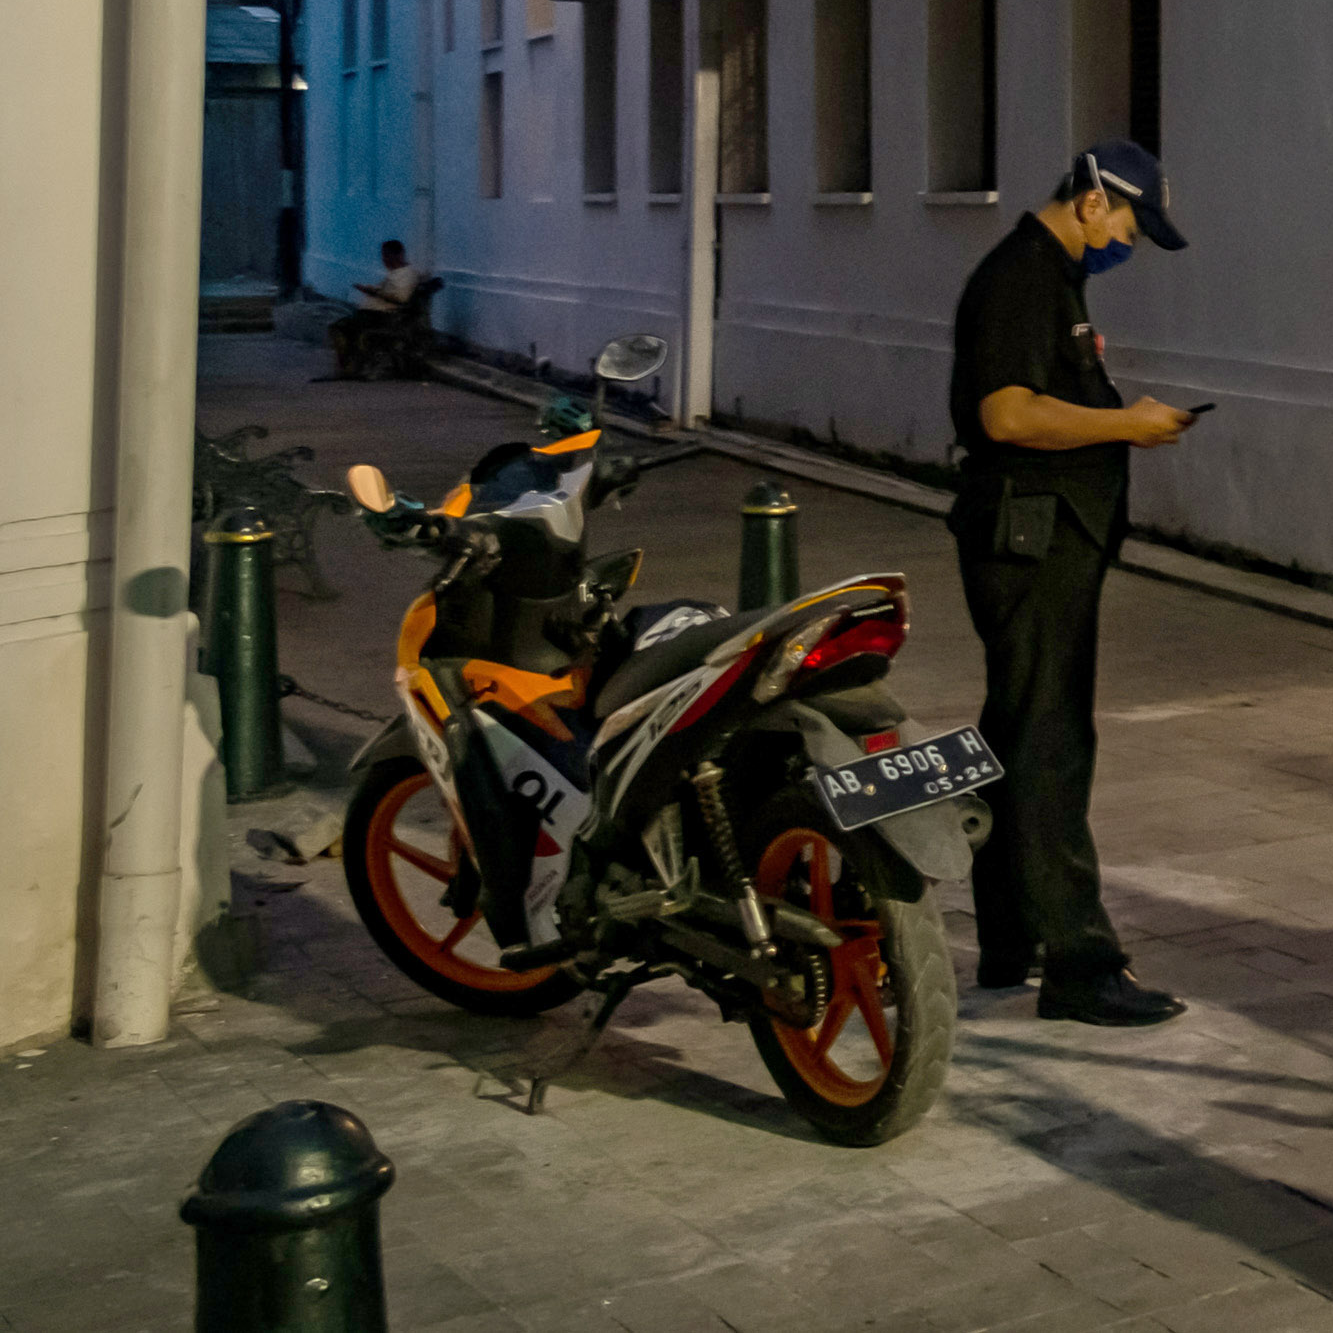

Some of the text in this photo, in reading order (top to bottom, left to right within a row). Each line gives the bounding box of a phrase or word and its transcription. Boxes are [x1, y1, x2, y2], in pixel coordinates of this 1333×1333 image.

[824, 731, 983, 798] AB 6906 H
